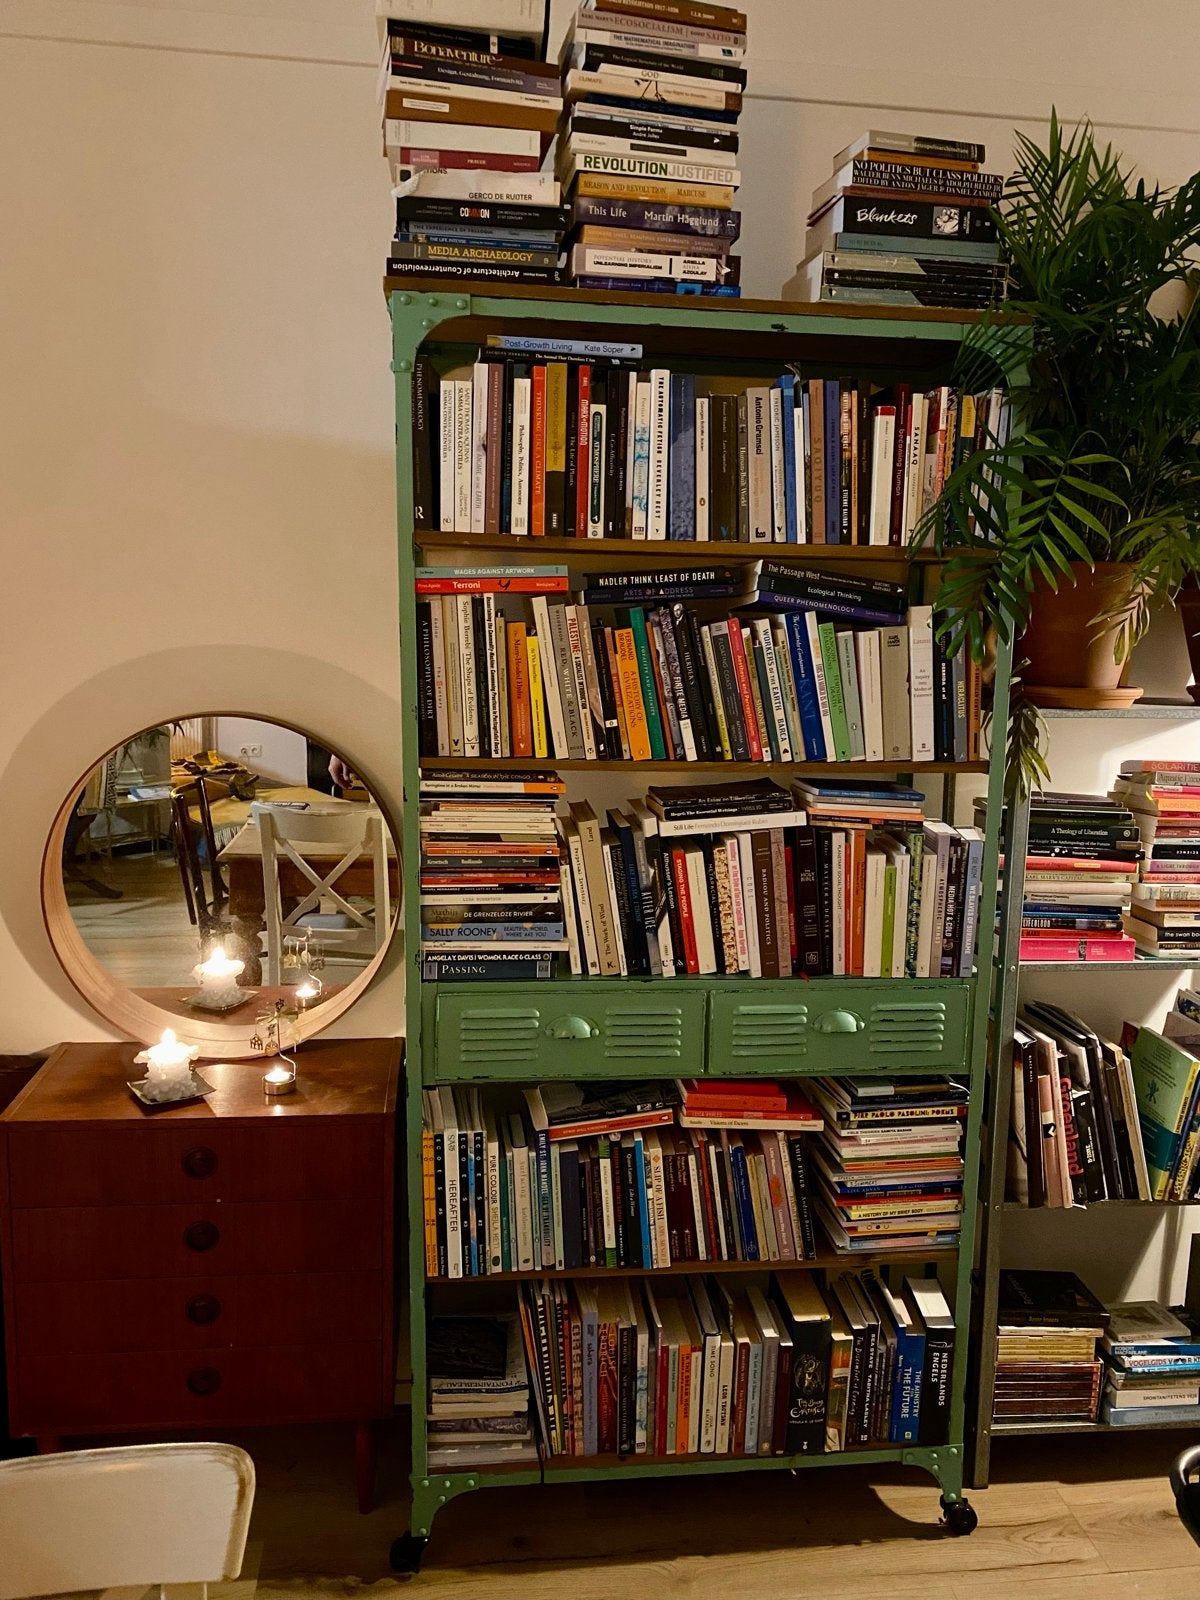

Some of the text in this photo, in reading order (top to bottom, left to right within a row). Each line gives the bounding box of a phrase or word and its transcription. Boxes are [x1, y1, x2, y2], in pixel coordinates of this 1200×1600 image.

[615, 17, 683, 35] ECOSOCIALISM
[624, 36, 661, 46] MATHEMATICAL
[663, 40, 695, 49] IMAGINATION
[641, 70, 659, 78] GOD
[584, 156, 733, 182] REVOLUTION JUSTIFIED
[854, 160, 1003, 184] NO POLITICS BUT CLASS POLITICS
[469, 192, 493, 200] GERCO
[584, 181, 609, 190] REASON
[626, 184, 666, 194] REVOLUTION
[677, 188, 706, 198] MARCUSE
[589, 206, 719, 227] This Life Martin Hägglund
[857, 207, 918, 225] Blankets
[428, 246, 533, 262] MEDIA ARCHAEOLOGY
[393, 264, 520, 277] Architecture of Counterrevolution
[504, 339, 624, 354] Post-Growth Living Kate Soper
[416, 363, 424, 431] PHENOMENOLOGY
[754, 397, 763, 455] Antonio Gramsci
[896, 429, 905, 467] becoming
[911, 426, 920, 465] SANAAQ
[599, 571, 715, 587] NADLER THINK LEAST OF DEATH
[768, 563, 820, 580] The Passage West
[452, 581, 481, 589] Terroni
[807, 586, 861, 602] Ecological Thinking
[774, 594, 855, 613] QUEER PHENOMENOLOGY
[422, 629, 431, 683] PHILOSOPHY
[624, 632, 635, 661] FERNAND
[568, 618, 580, 655] PALESTINE:
[577, 681, 587, 710] INTRODUCTION
[718, 638, 732, 690] FLOATING COAST
[630, 678, 641, 710] HISTORY
[762, 628, 774, 666] WORKERS
[772, 686, 782, 711] EARTH
[777, 719, 787, 742] BARCA
[623, 671, 639, 728] CIVILIZATIONS
[673, 676, 687, 718] FINITE MEDIA
[957, 680, 965, 719] HERACLITUS
[1056, 828, 1077, 836] Theology
[663, 852, 675, 909] Althusser's Lesson
[641, 892, 656, 928] AFTER ICE
[430, 927, 497, 937] SALLY ROONEY
[442, 965, 486, 974] PASSING
[1060, 1077, 1084, 1175] Groenland
[794, 1144, 802, 1162] SHIP
[797, 1165, 805, 1188] FEVER
[655, 1184, 663, 1193] OF
[449, 1179, 457, 1232] HEREAFTER
[657, 1203, 665, 1220] FISH
[931, 1352, 939, 1382] ENGELS
[1129, 1359, 1166, 1367] VOGELGIDS
[938, 1352, 948, 1406] NEDERLANDS
[901, 1367, 912, 1418] THE FUTURE
